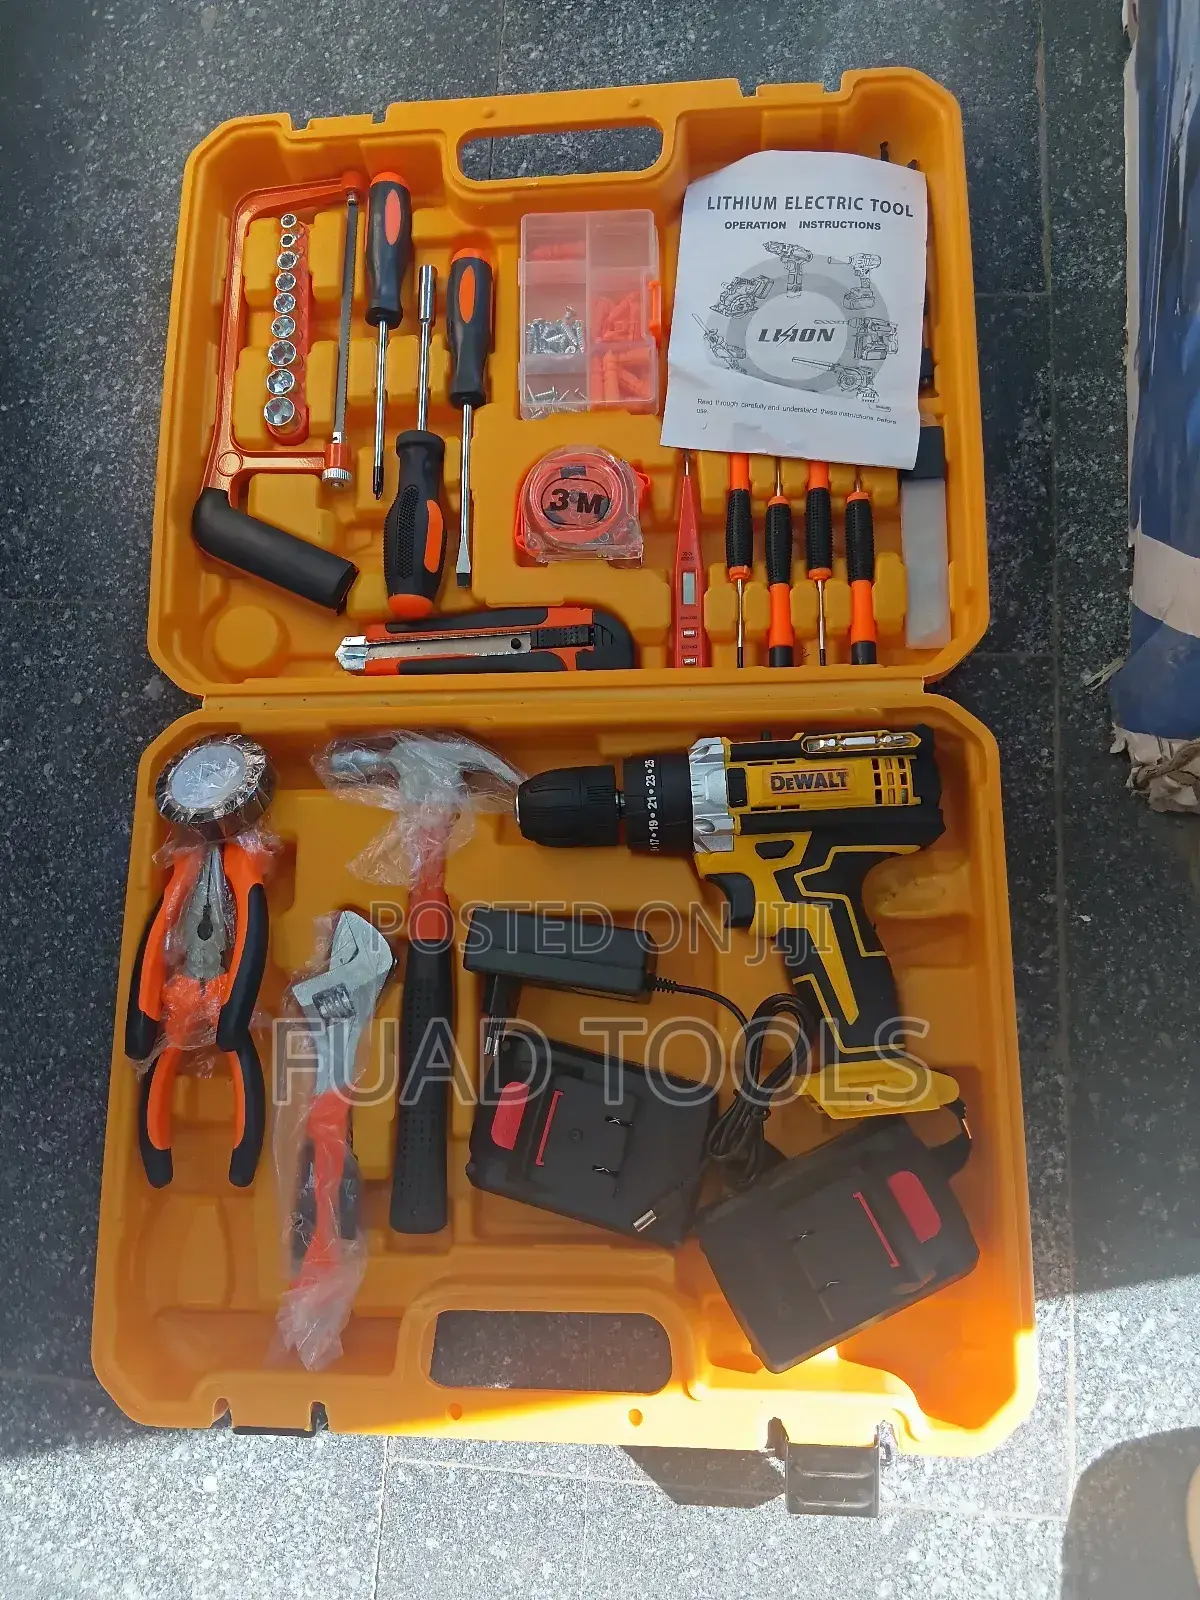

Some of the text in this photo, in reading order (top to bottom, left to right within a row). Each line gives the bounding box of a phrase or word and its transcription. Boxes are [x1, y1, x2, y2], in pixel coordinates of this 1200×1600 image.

[707, 195, 914, 218] LITHIUM ELECTRIC TOOL
[724, 220, 881, 231] OPERATION INSTRUCTIONS
[715, 400, 739, 409] through
[741, 402, 767, 411] carefully
[782, 405, 818, 414] understand
[820, 407, 838, 416] these
[838, 410, 874, 421] instructions
[876, 416, 897, 425] before
[644, 759, 655, 768] 25
[645, 774, 656, 787] 23
[646, 796, 658, 810] 21
[648, 819, 659, 832] 19
